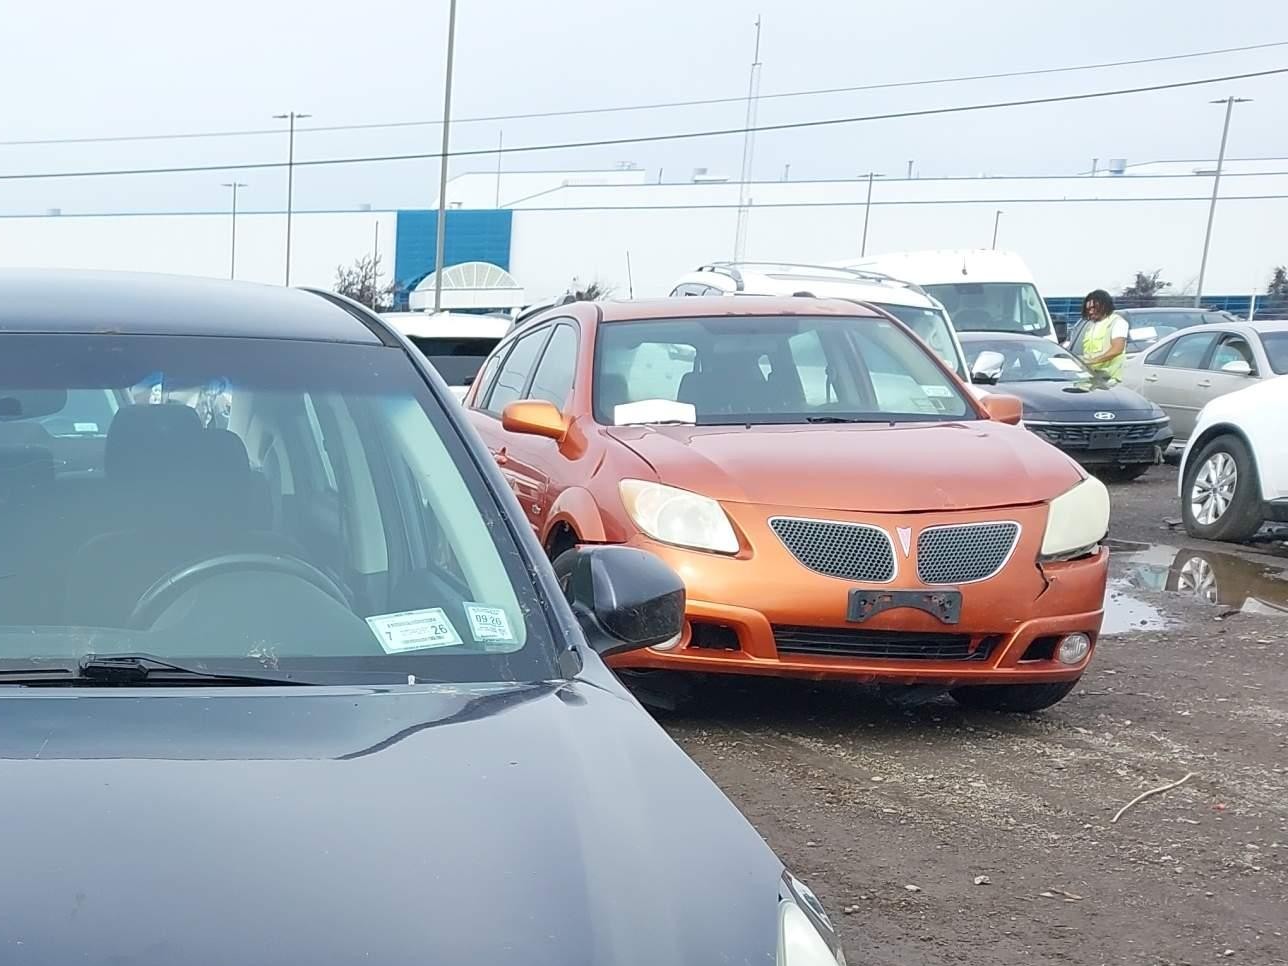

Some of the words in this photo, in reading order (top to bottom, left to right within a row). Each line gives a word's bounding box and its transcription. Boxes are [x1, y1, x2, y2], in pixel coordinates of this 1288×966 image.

[475, 614, 488, 623] 09
[385, 631, 393, 641] 7
[431, 624, 448, 635] 26
